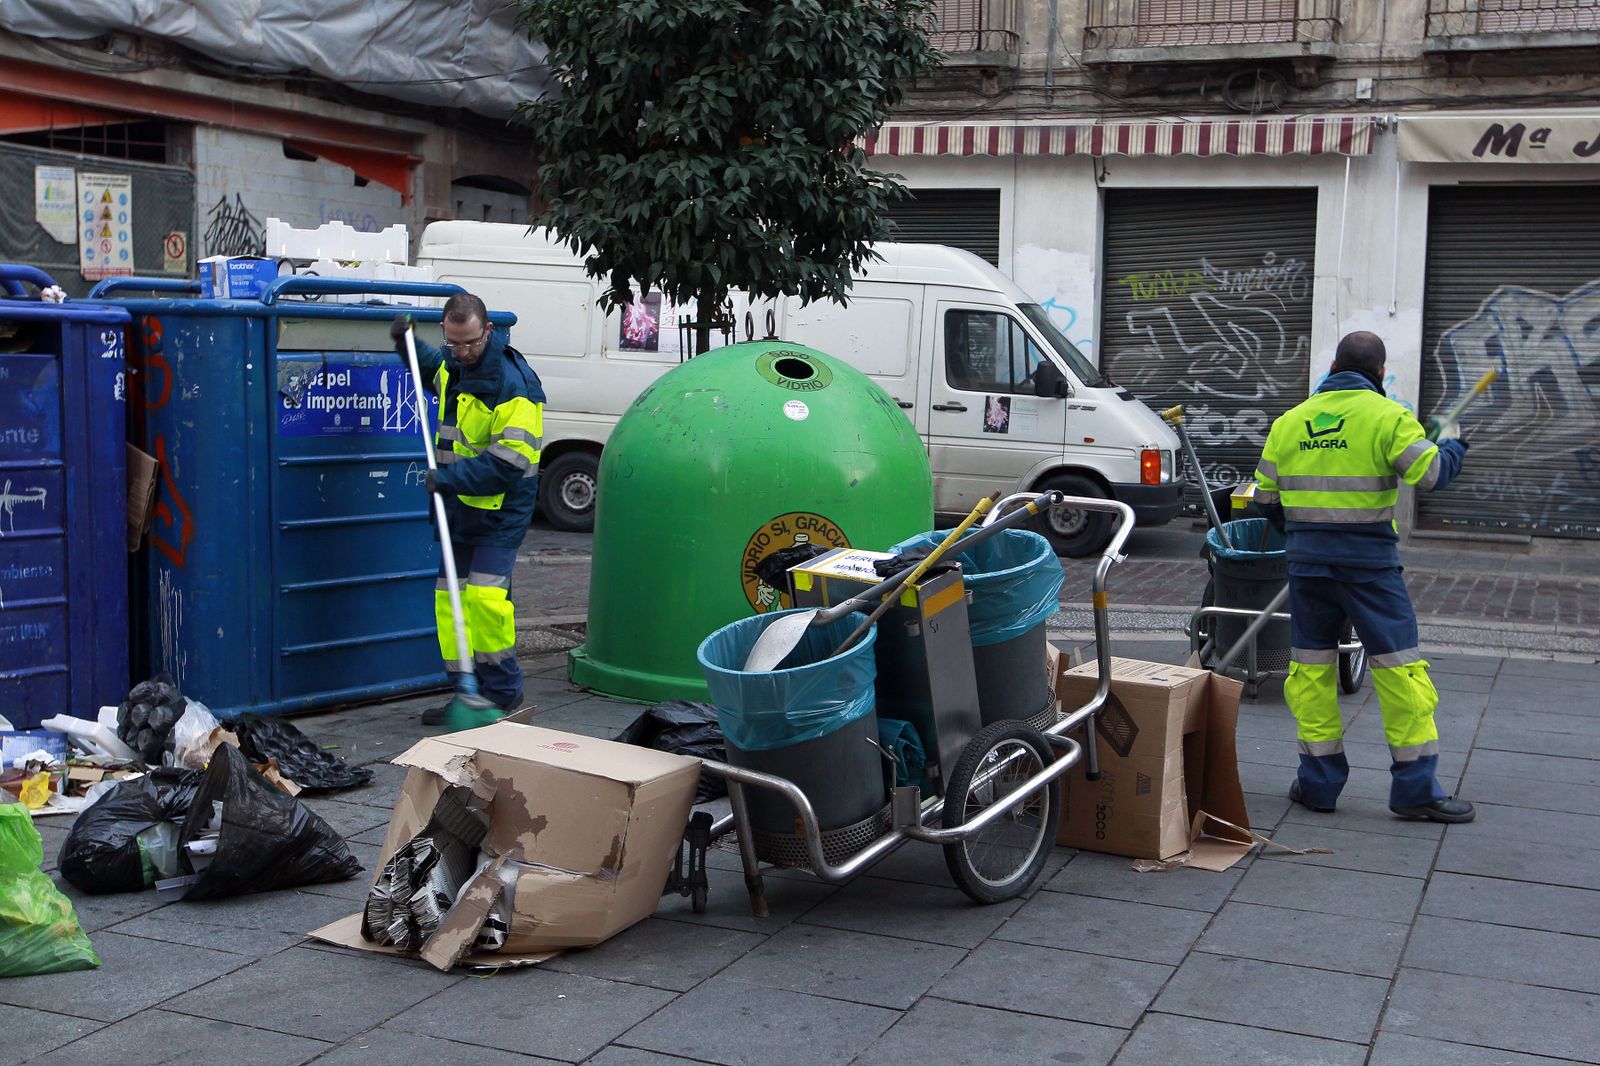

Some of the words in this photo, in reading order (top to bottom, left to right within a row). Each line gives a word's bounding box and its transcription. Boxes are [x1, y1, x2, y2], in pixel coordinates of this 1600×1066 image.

[769, 350, 809, 360] SOLO
[776, 378, 824, 391] VIDRIO
[307, 392, 391, 412] importante
[1300, 439, 1348, 451] INAGRA
[744, 532, 771, 585] VIDRIO
[770, 520, 791, 537] SI,
[795, 516, 846, 547] GRACIA
[0, 564, 53, 580] mbiente
